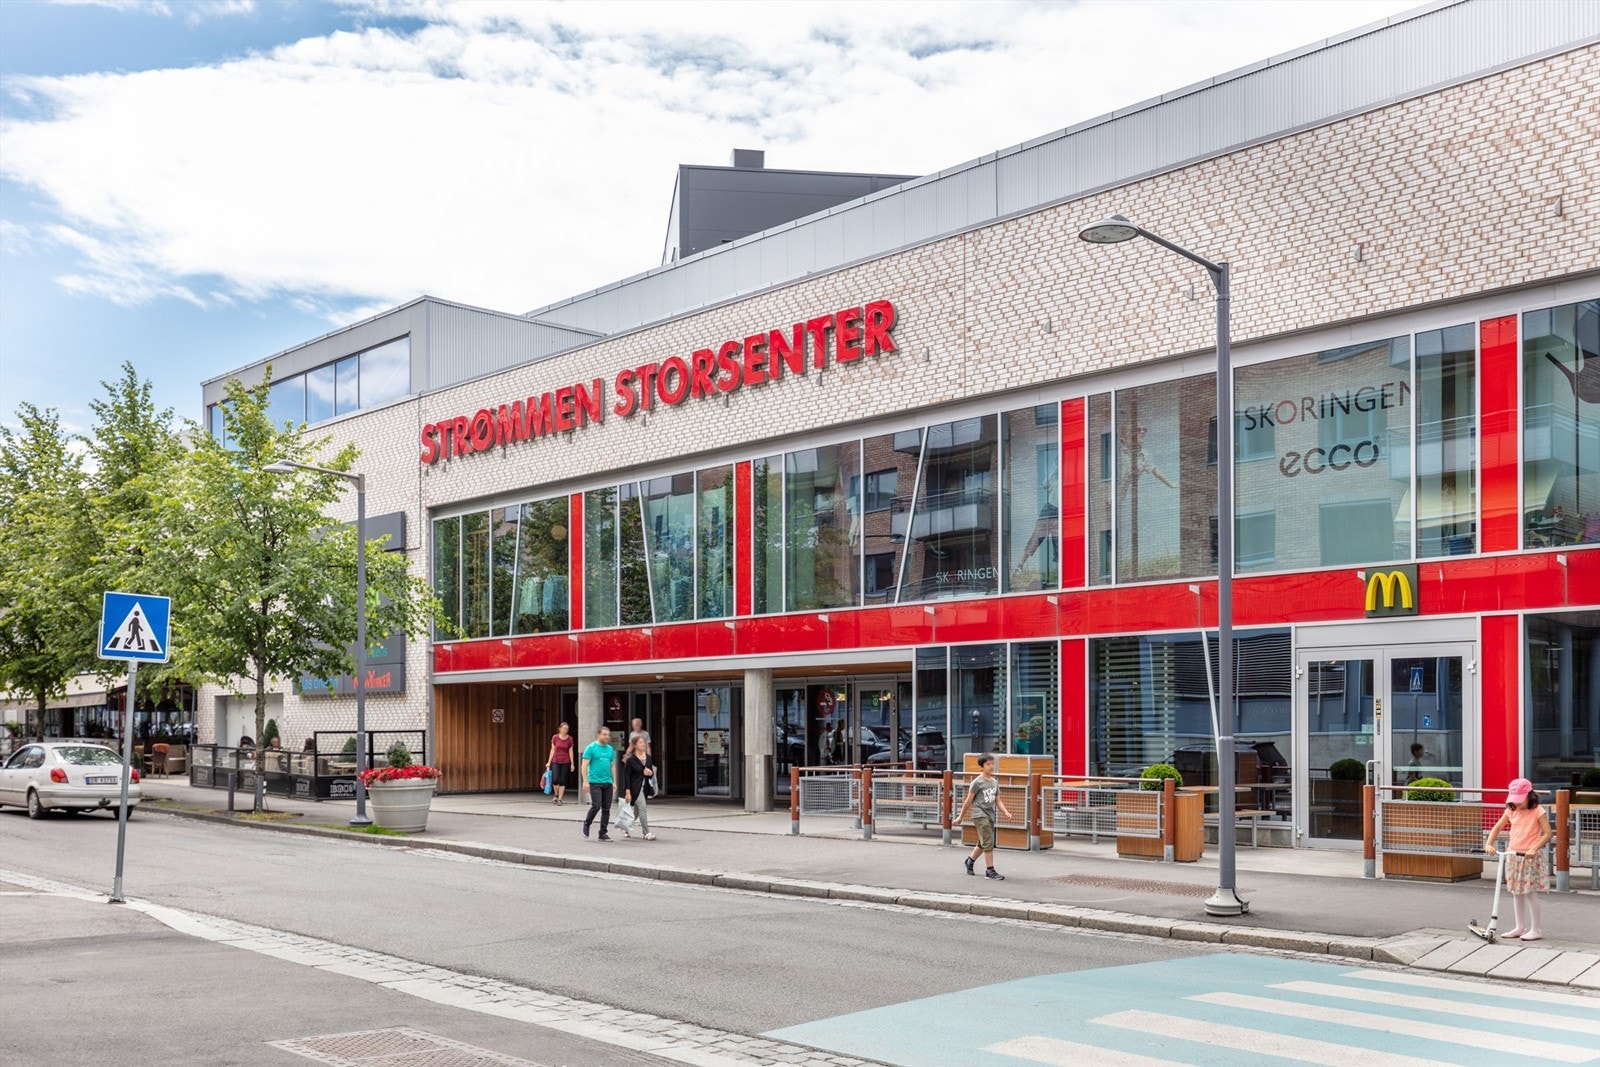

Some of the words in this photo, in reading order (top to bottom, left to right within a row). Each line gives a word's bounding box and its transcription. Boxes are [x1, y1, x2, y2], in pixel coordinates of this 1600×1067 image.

[420, 378, 603, 464] STRØMMEN
[614, 299, 898, 417] STORSENTER
[1244, 381, 1411, 431] SKORINGEN
[1279, 440, 1380, 478] ecco
